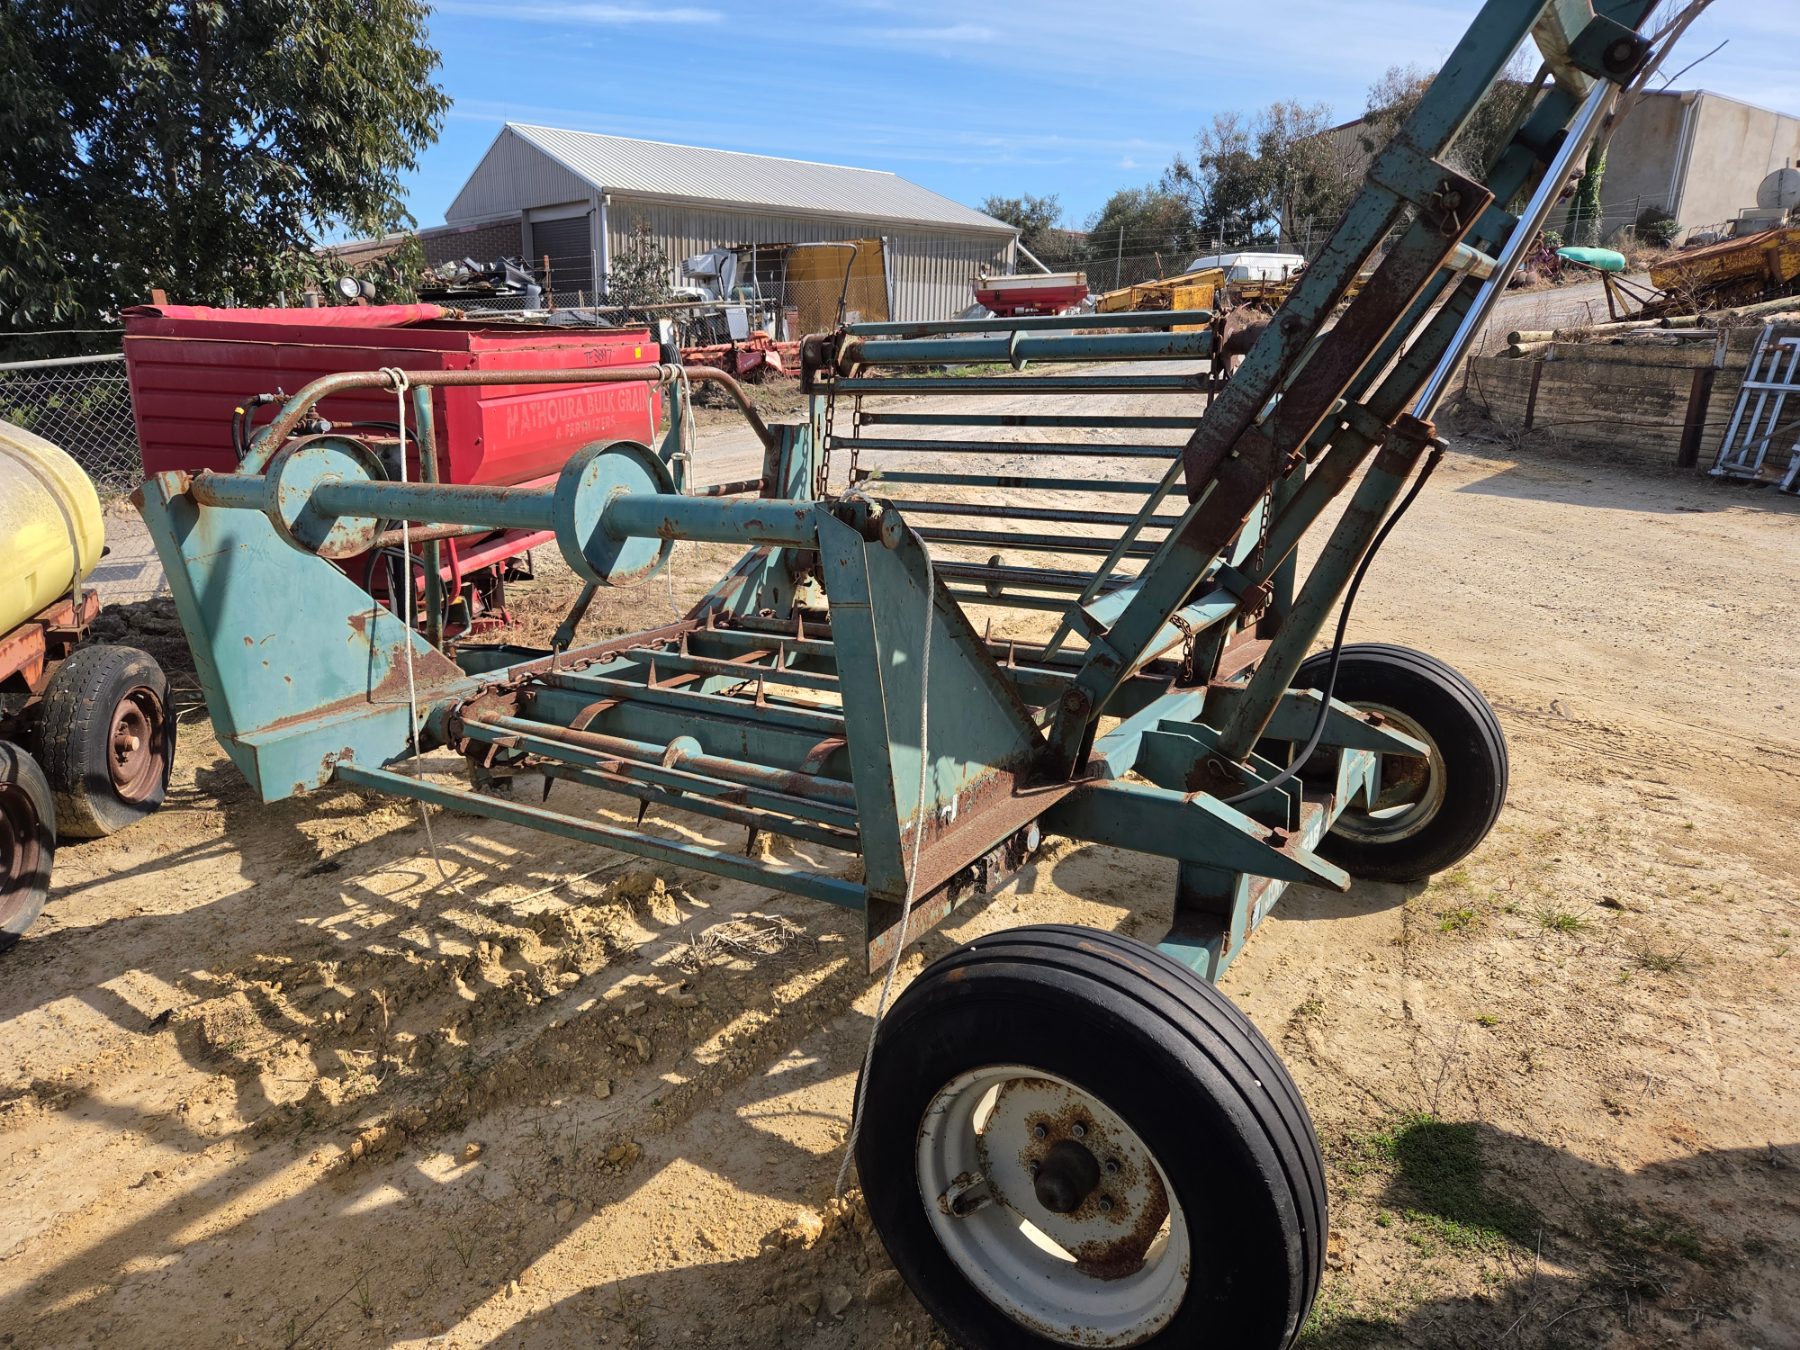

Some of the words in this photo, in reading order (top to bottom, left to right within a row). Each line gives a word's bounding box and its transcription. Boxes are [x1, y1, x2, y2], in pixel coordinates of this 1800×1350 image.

[506, 396, 585, 440] MATHOURA
[587, 391, 615, 416] BULK
[617, 385, 648, 413] GRAIN
